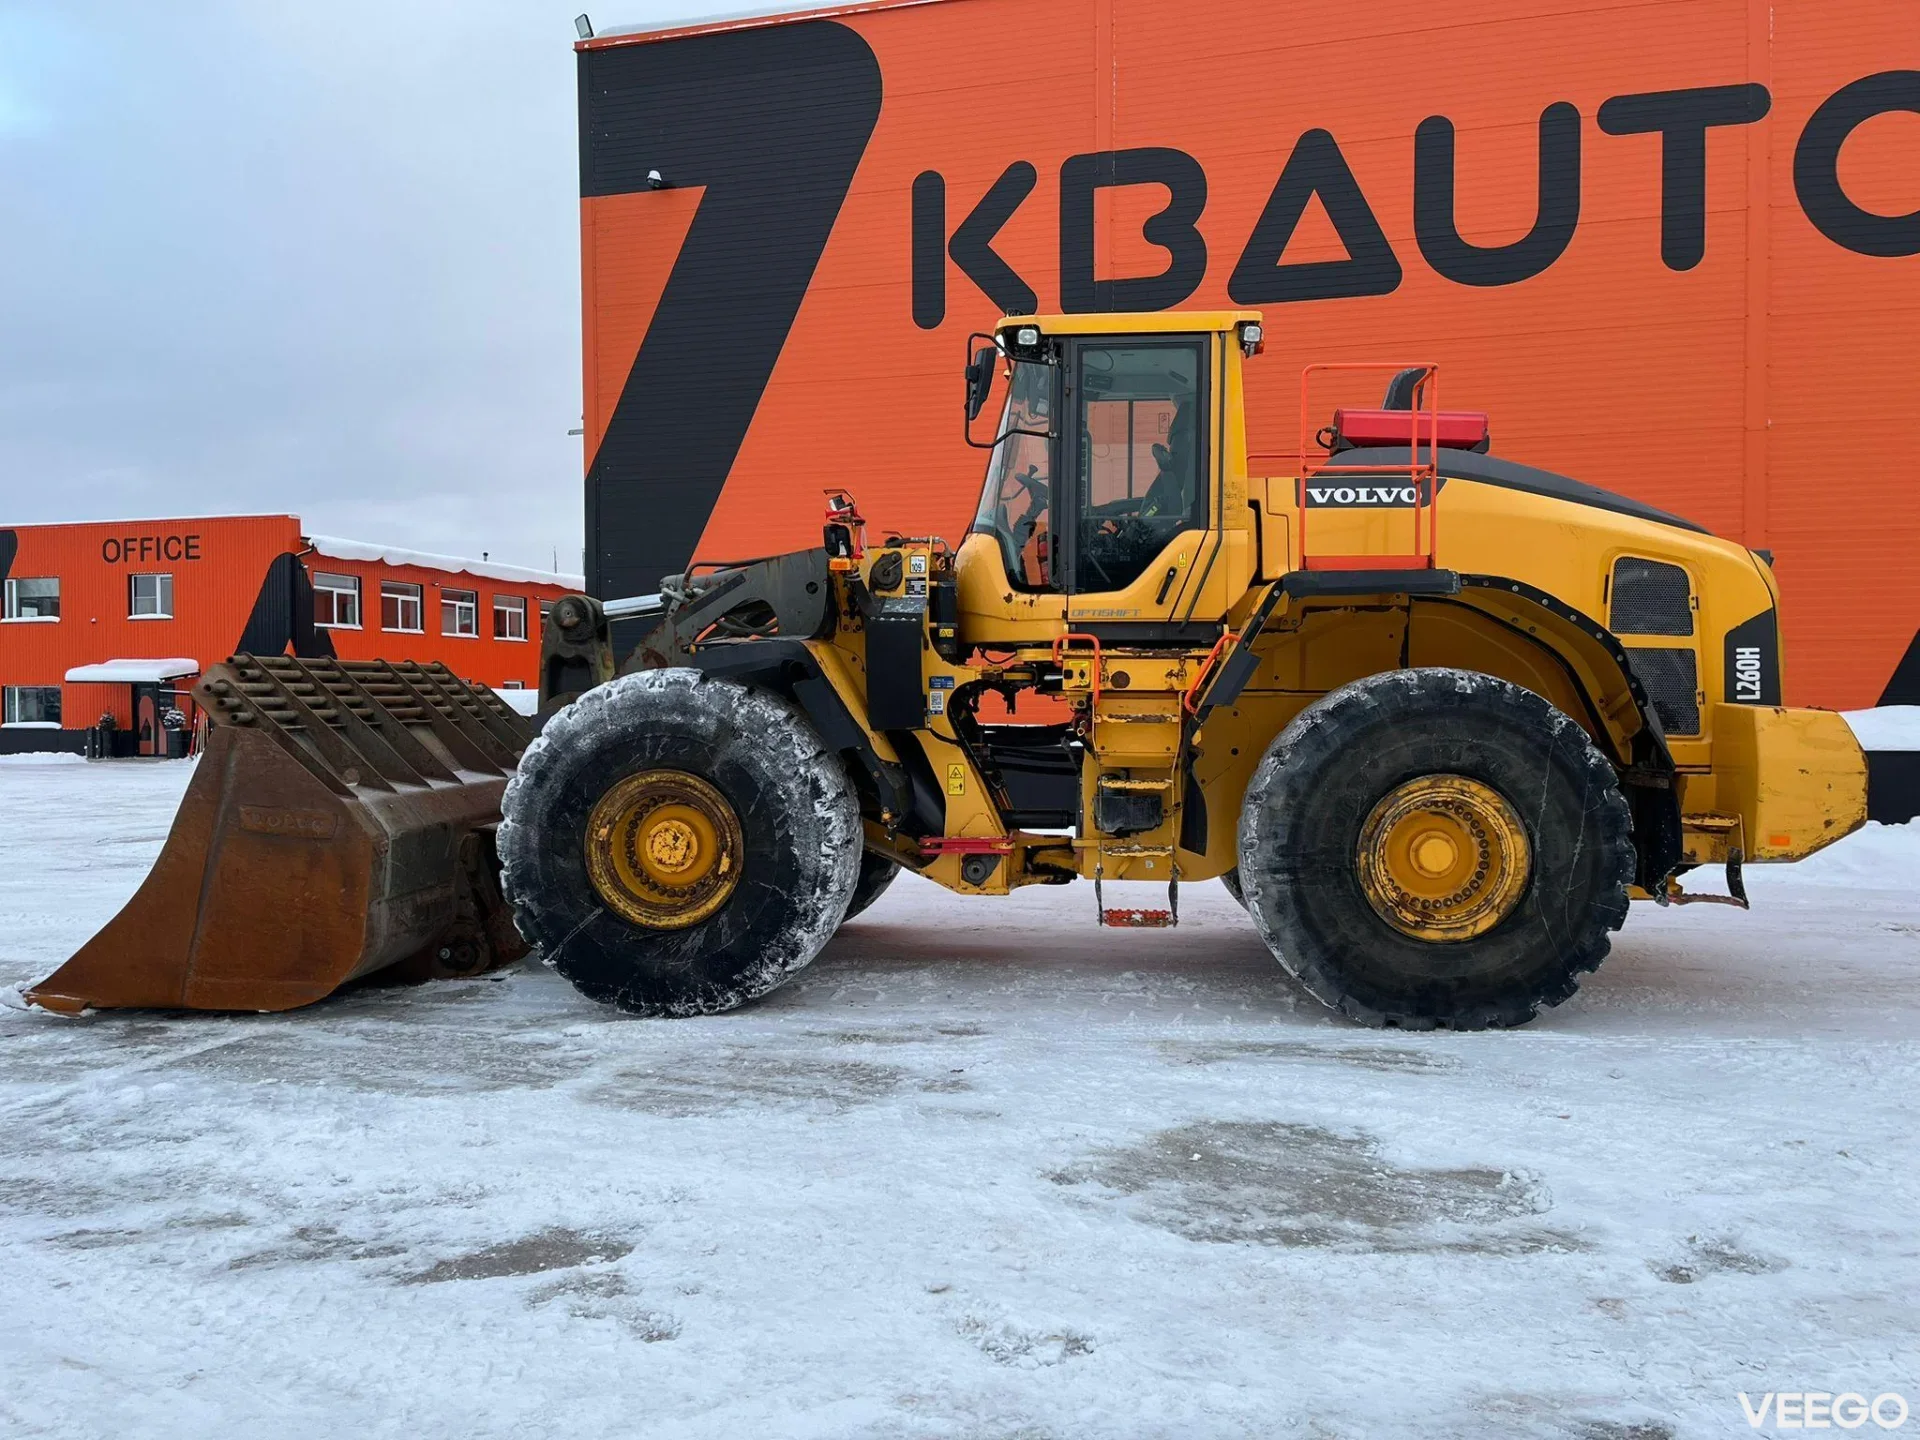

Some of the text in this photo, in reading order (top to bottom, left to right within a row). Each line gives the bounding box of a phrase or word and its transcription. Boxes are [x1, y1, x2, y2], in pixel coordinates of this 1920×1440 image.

[912, 69, 1920, 330] KBAUTO
[1306, 487, 1423, 503] VOLVO
[102, 535, 201, 563] OFFICE
[1071, 608, 1142, 617] OPTISHIFT
[1736, 647, 1760, 700] L260H
